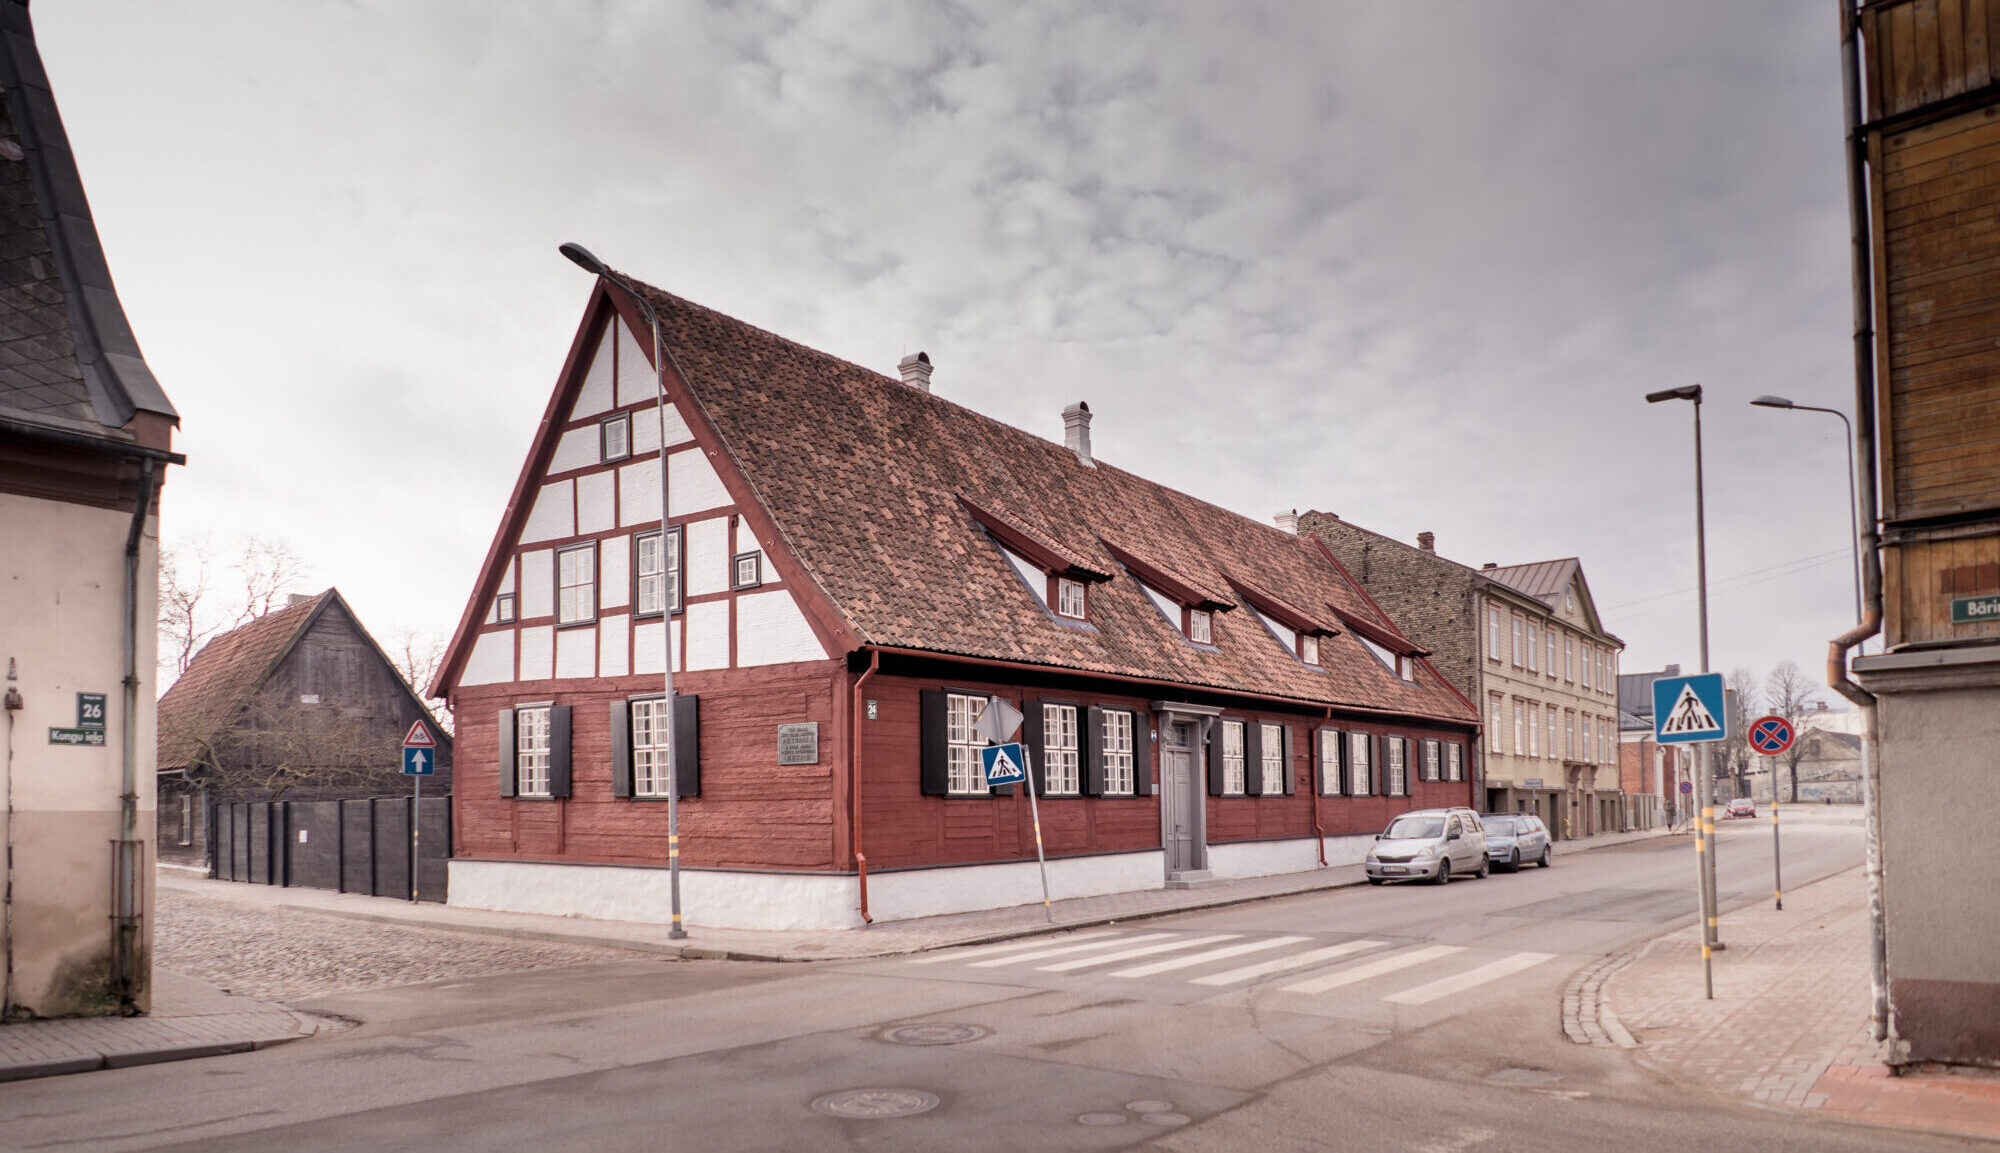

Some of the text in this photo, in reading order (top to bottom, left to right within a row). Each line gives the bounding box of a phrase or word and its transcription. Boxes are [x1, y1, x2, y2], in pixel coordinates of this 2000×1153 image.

[1968, 599, 2000, 616] Bāri
[83, 703, 102, 718] 26
[52, 730, 104, 744] Kungu iela
